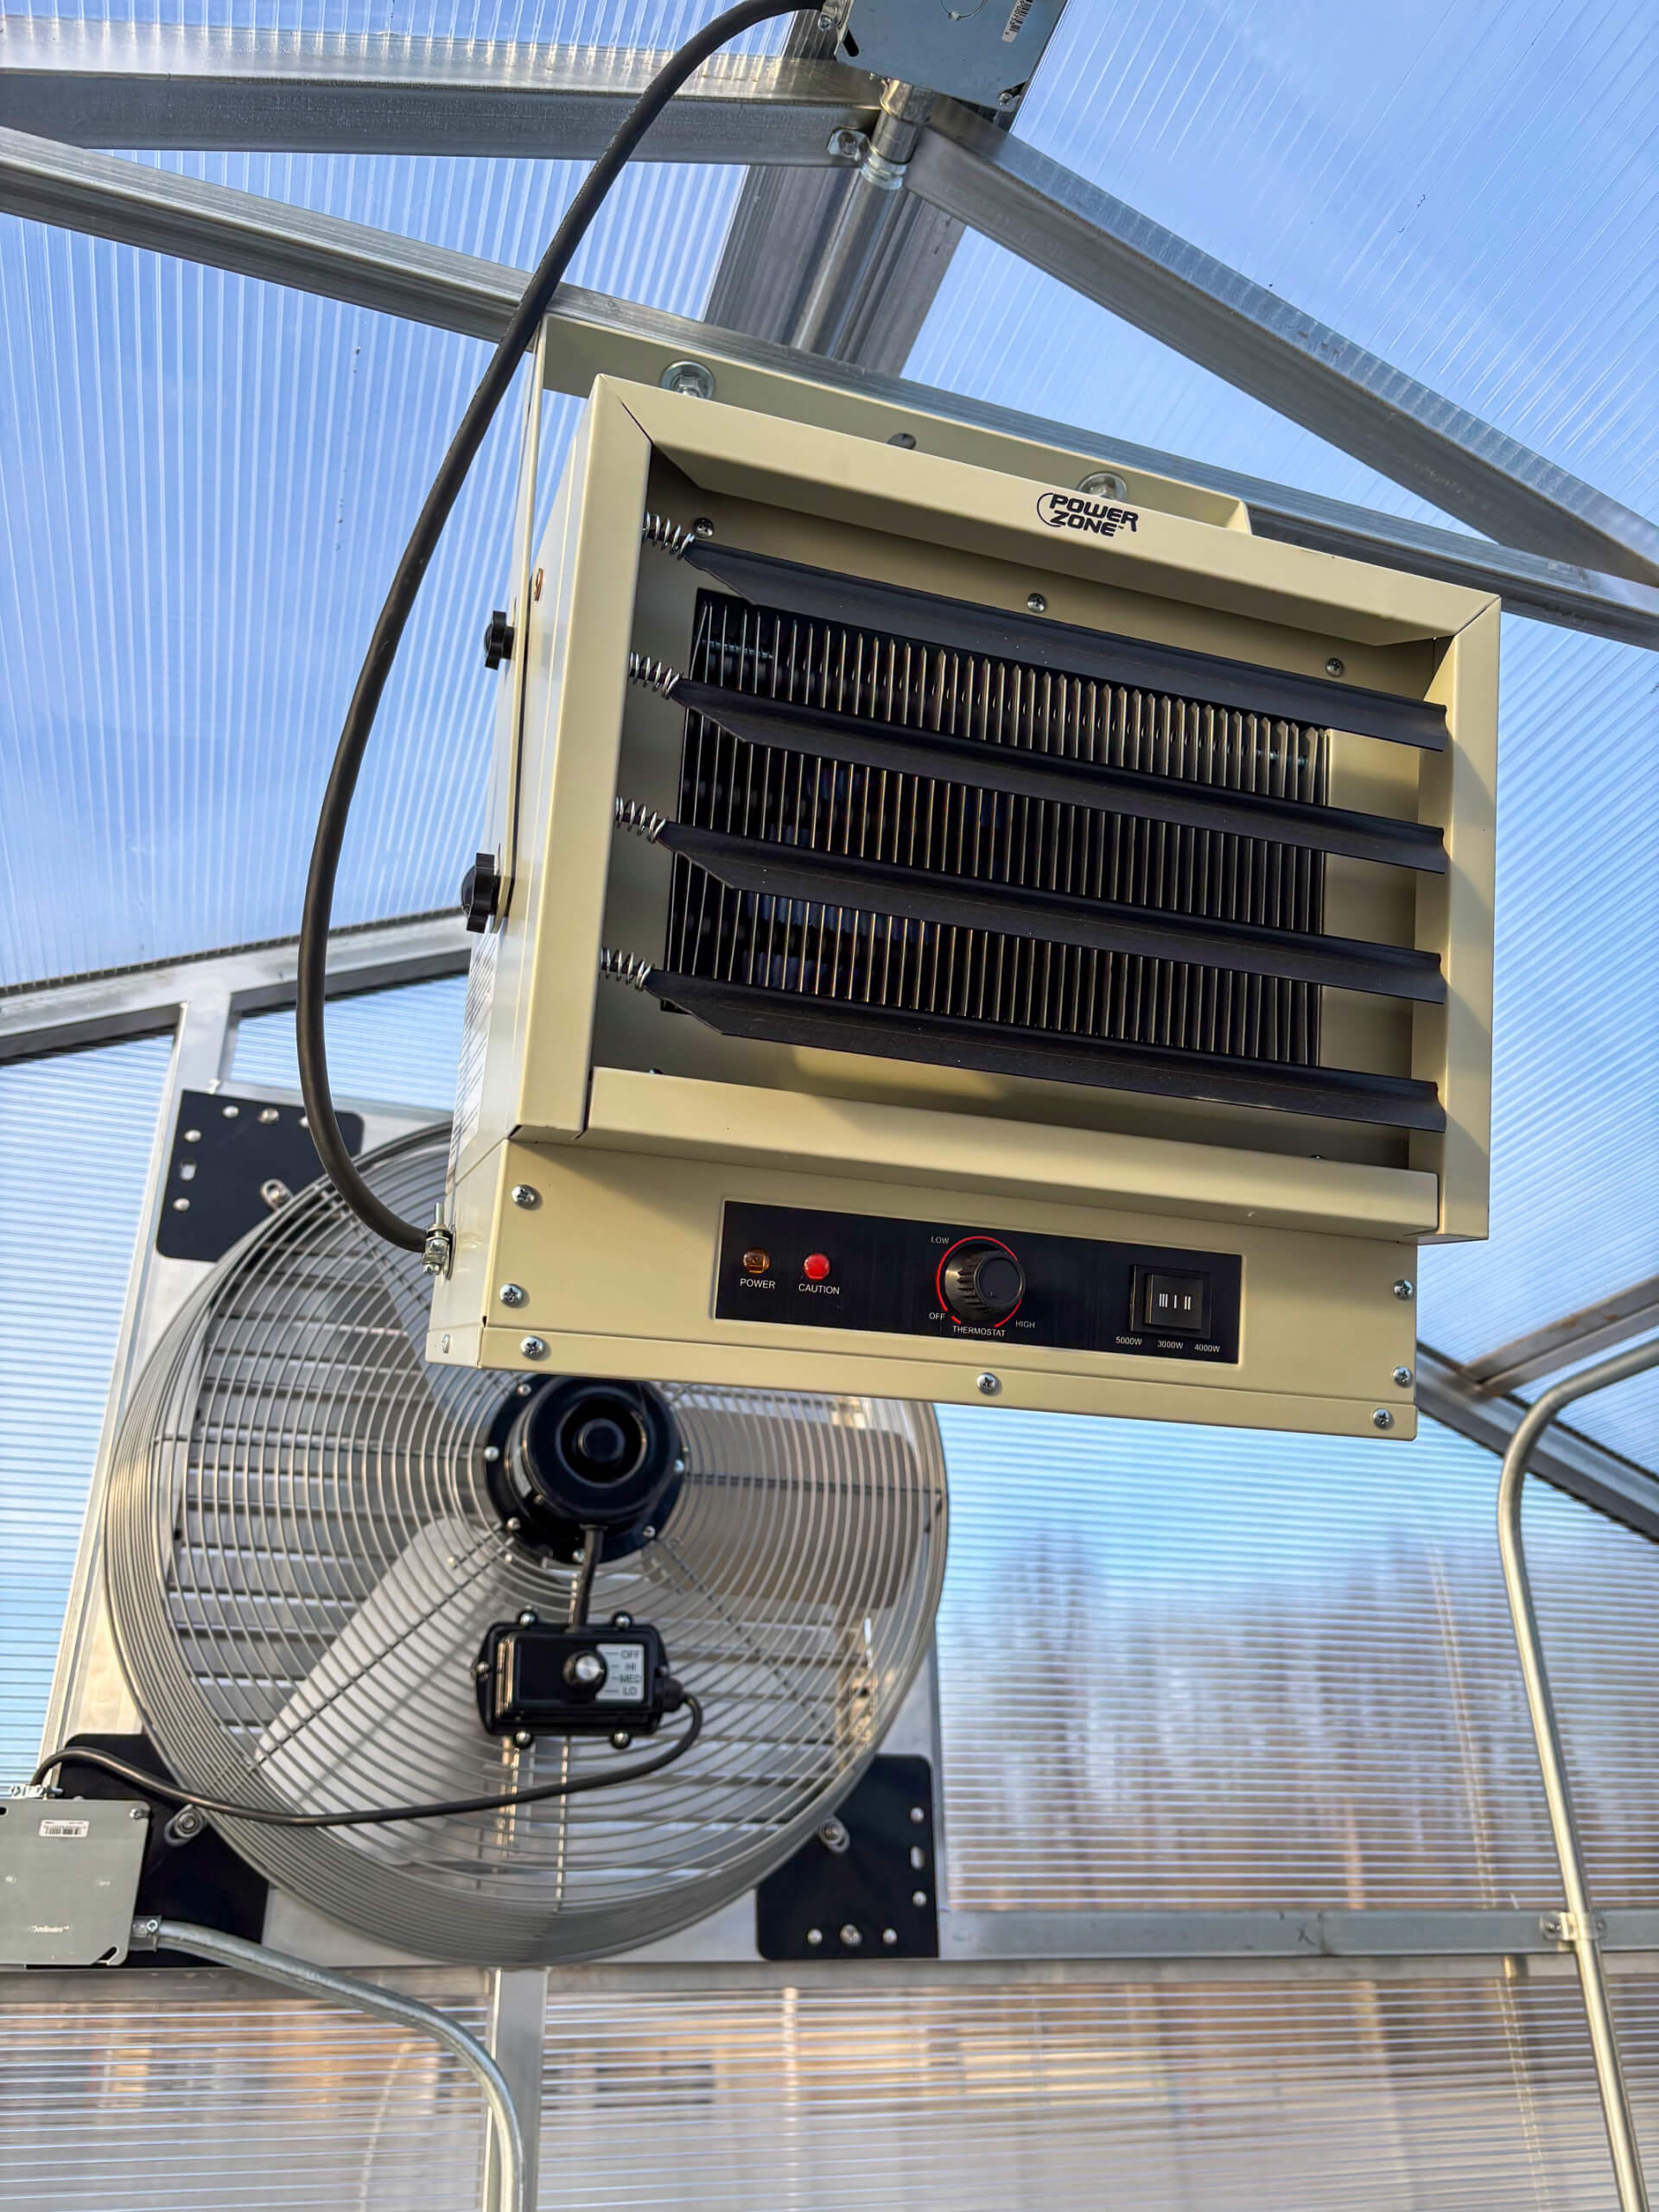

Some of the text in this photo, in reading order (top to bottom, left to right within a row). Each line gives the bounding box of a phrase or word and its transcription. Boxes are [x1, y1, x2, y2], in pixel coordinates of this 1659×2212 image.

[1049, 493, 1139, 532] POWER
[931, 1236, 950, 1244] LOW
[740, 1278, 776, 1289] POWER
[798, 1283, 840, 1295] CAUTION
[928, 1312, 945, 1320] OFF
[1015, 1320, 1036, 1329] HIGH
[952, 1325, 1006, 1337] THERMOSTAT
[1116, 1336, 1221, 1353] 5000W 3000W 4000W
[620, 1649, 640, 1660] OFF
[625, 1662, 637, 1672] HI
[620, 1674, 641, 1684] MED
[622, 1686, 638, 1695] LO
